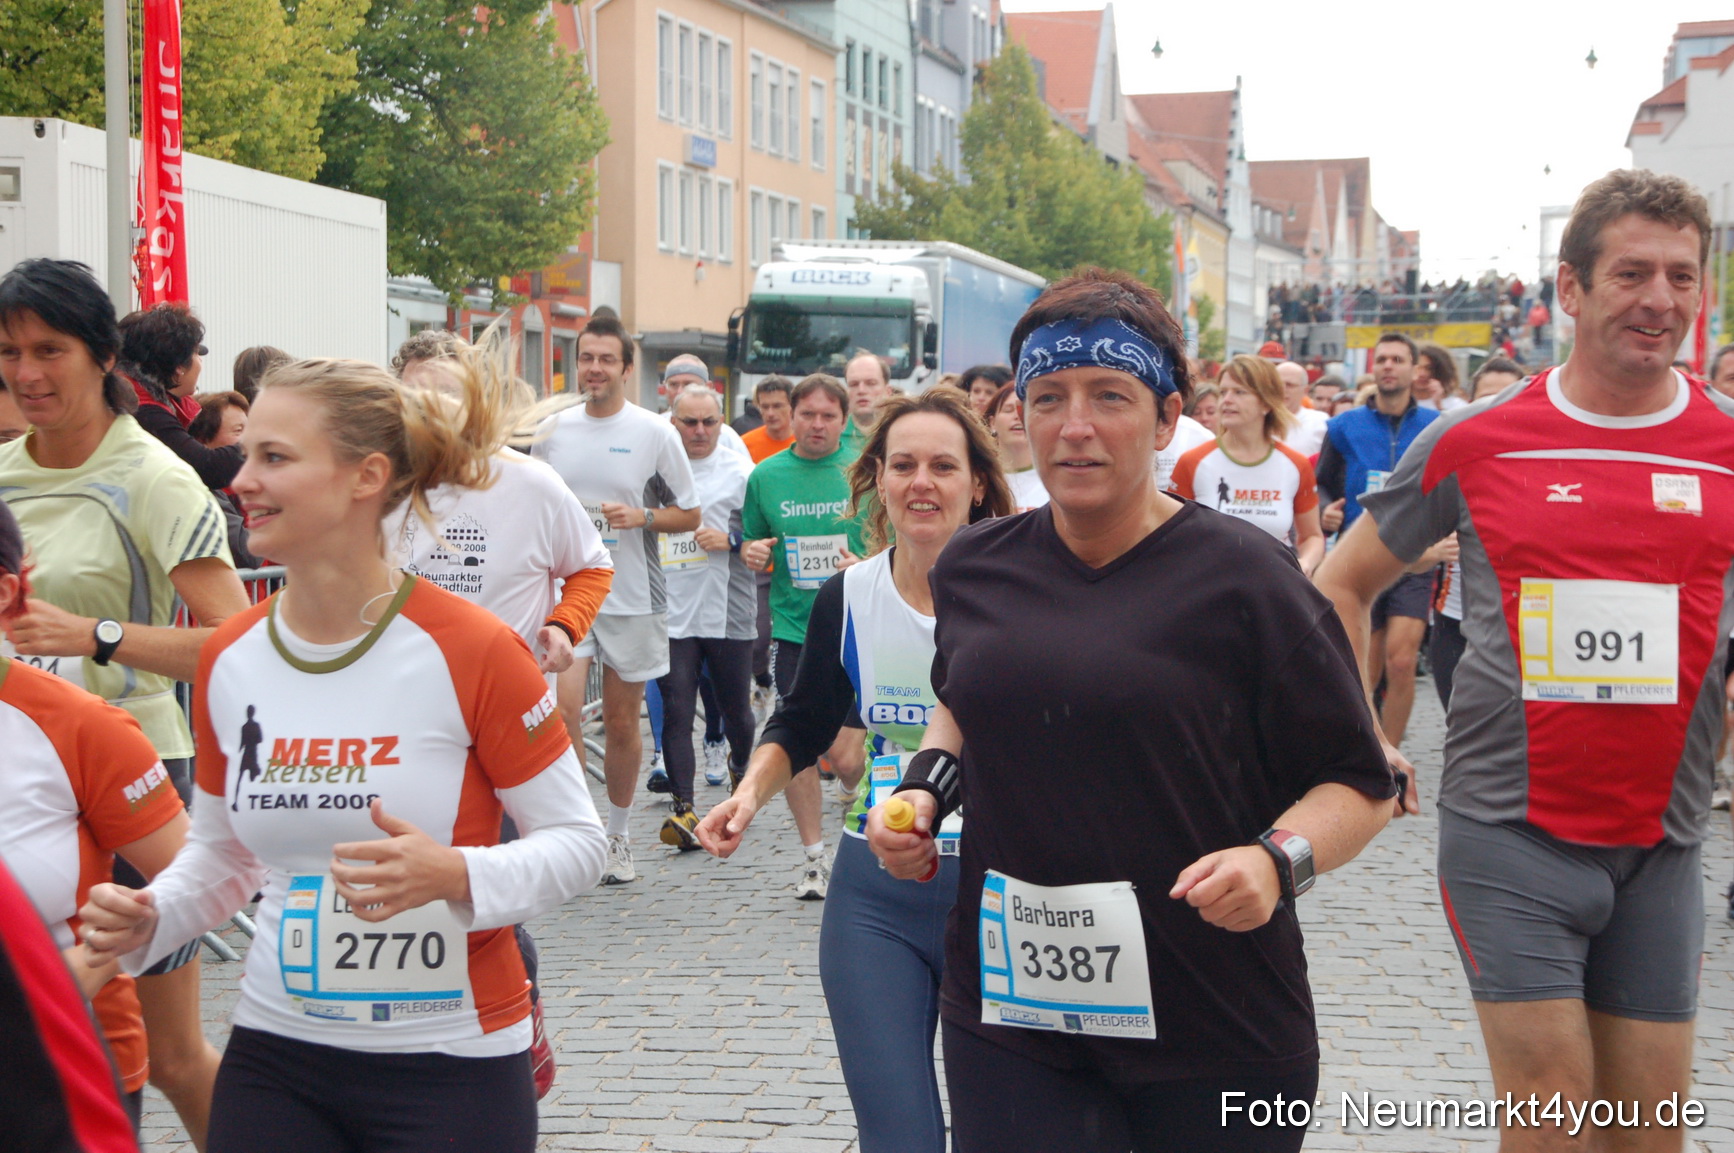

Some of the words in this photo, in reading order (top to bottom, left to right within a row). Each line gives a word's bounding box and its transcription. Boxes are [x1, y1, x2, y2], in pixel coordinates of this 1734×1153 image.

[791, 269, 872, 286] BOCK
[1234, 489, 1282, 501] MERZ
[672, 540, 697, 556] 780
[800, 542, 833, 551] Reinhold
[802, 555, 840, 571] 2310
[415, 571, 483, 583] Neumarkter
[1575, 631, 1644, 662] 991
[875, 685, 921, 697] TEAM
[271, 735, 400, 767] MERZ
[260, 757, 368, 784] Reisen
[123, 760, 168, 801] MER
[248, 794, 309, 810] TEAM
[318, 794, 380, 810] 2008
[1012, 894, 1095, 928] Barbara
[334, 931, 446, 970] 2770
[1020, 940, 1121, 983] 3387
[393, 1000, 463, 1014] PFLEIDERER
[1000, 1006, 1040, 1023] BOCK
[1082, 1013, 1151, 1029] PFLEIDERER
